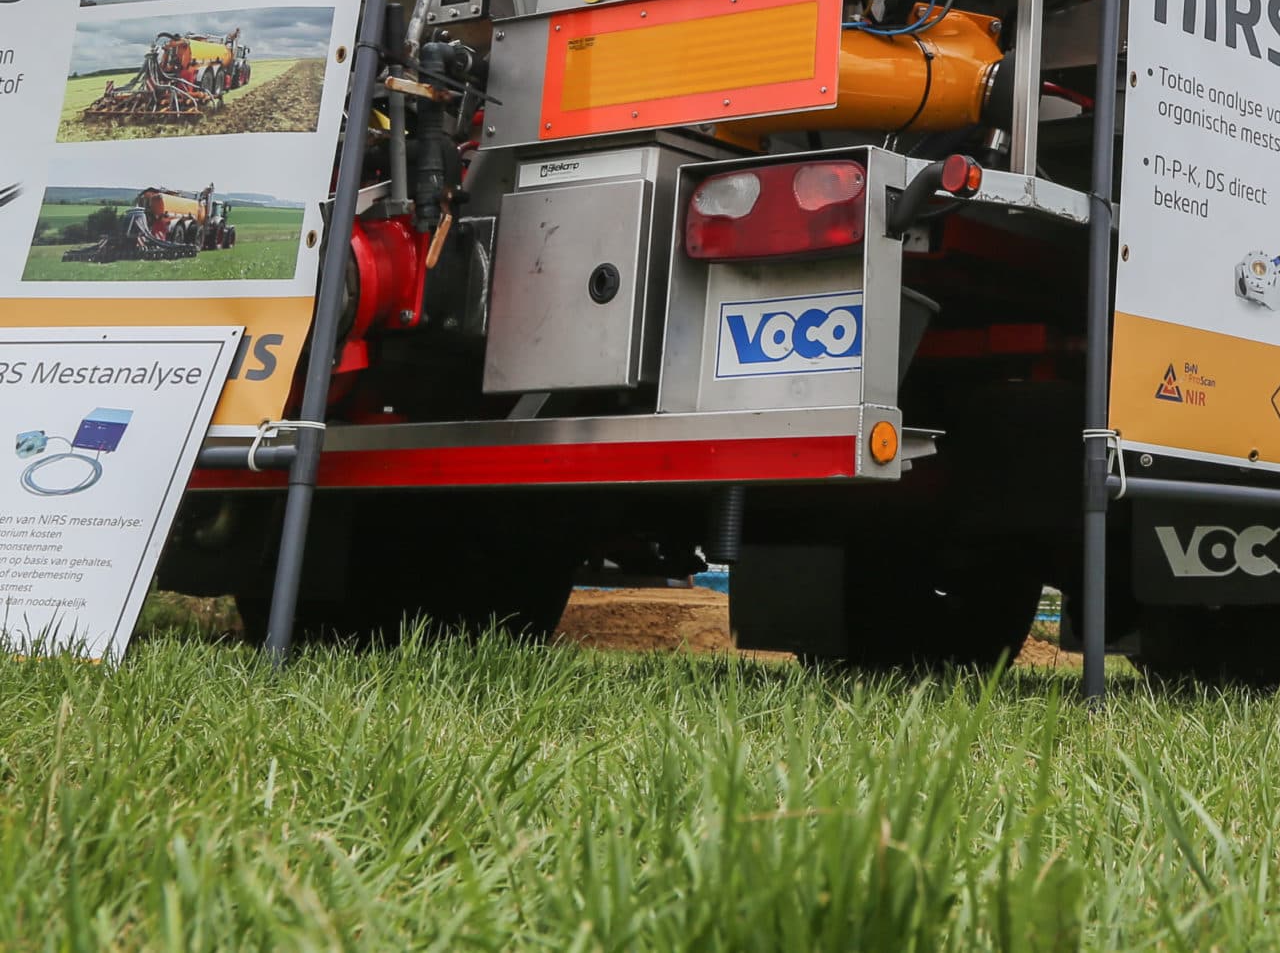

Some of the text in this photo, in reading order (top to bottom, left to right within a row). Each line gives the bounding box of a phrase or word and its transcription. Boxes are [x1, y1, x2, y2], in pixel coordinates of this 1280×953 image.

[1159, 65, 1204, 99] Totale
[1208, 87, 1263, 118] analyse
[1158, 101, 1237, 138] organische
[1206, 169, 1225, 192] DS
[1229, 177, 1267, 205] direct
[1154, 185, 1209, 218] bekend
[31, 361, 202, 391] Mestanalyse
[1185, 389, 1206, 407] NIR
[16, 515, 36, 526] van
[38, 515, 68, 526] NIRS
[69, 516, 144, 530] mestanalyse:
[30, 529, 62, 539] kosten
[8, 557, 22, 566] op
[24, 556, 48, 566] basis
[50, 558, 68, 566] van
[69, 558, 113, 568] gehaltes,
[11, 570, 83, 583] overbemesting
[26, 597, 87, 610] noodzakelijk
